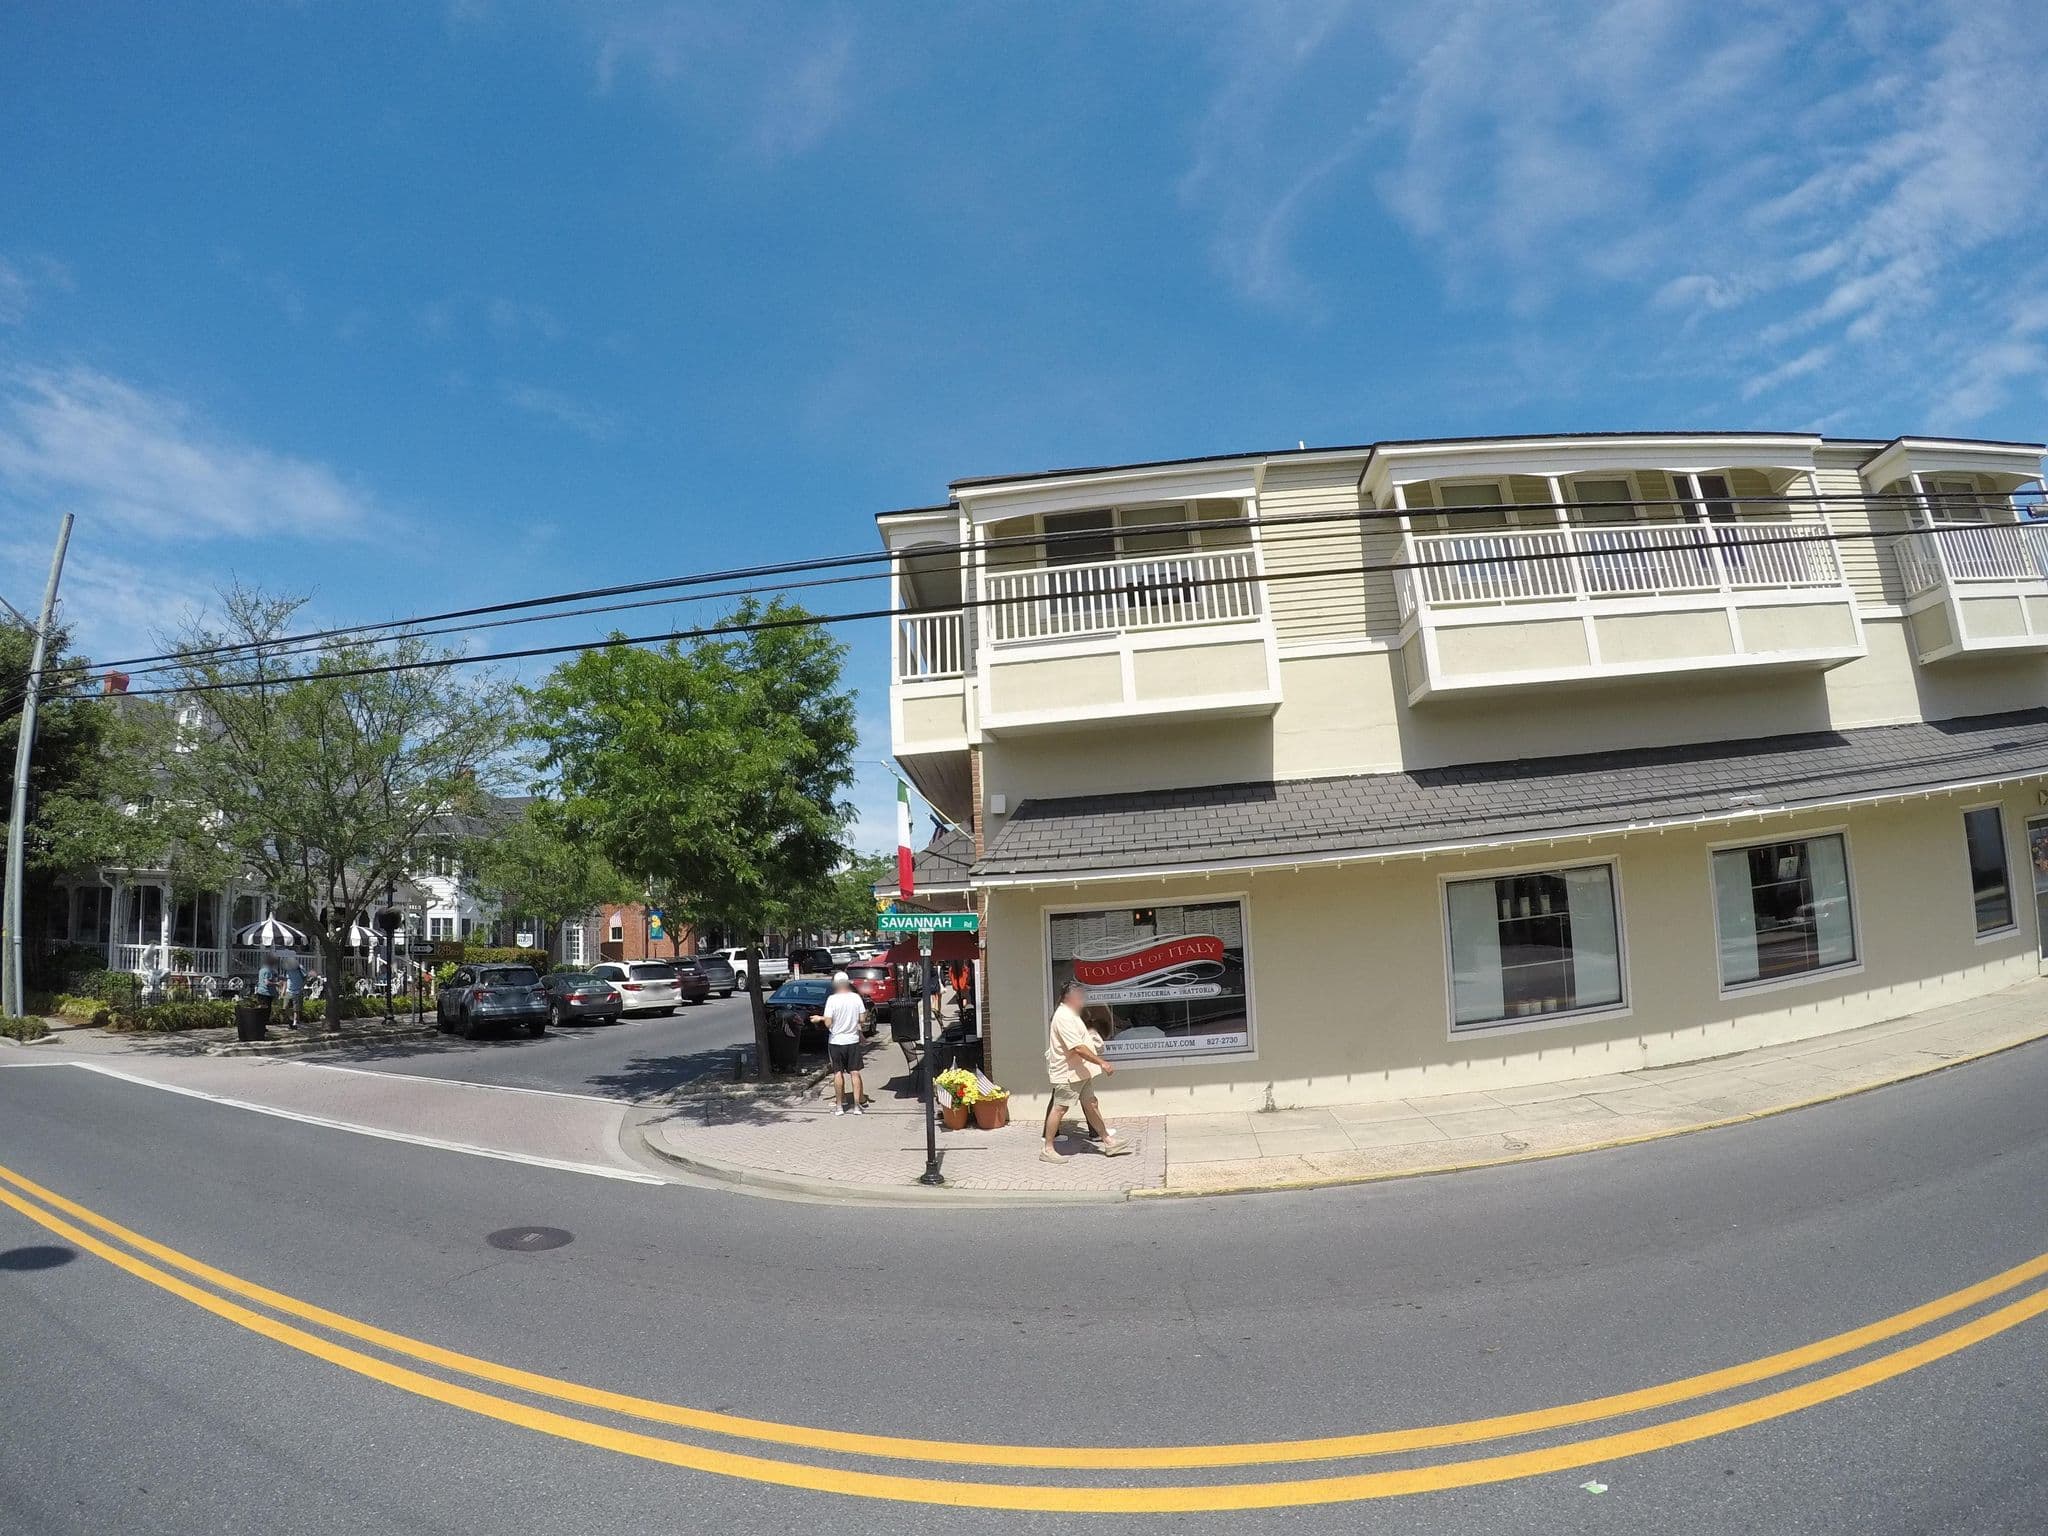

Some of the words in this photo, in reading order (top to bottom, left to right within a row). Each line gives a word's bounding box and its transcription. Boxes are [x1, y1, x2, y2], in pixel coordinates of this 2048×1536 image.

[881, 917, 952, 928] SAVANNAH
[1080, 958, 1143, 977] TOUCH
[1148, 953, 1163, 964] OF
[1168, 943, 1216, 958] ITALY
[1129, 990, 1171, 998] PASTICCERIA
[1105, 1039, 1196, 1051] WWW.TOUCHOFITALY.COM
[1206, 1037, 1238, 1046] 827-2730
